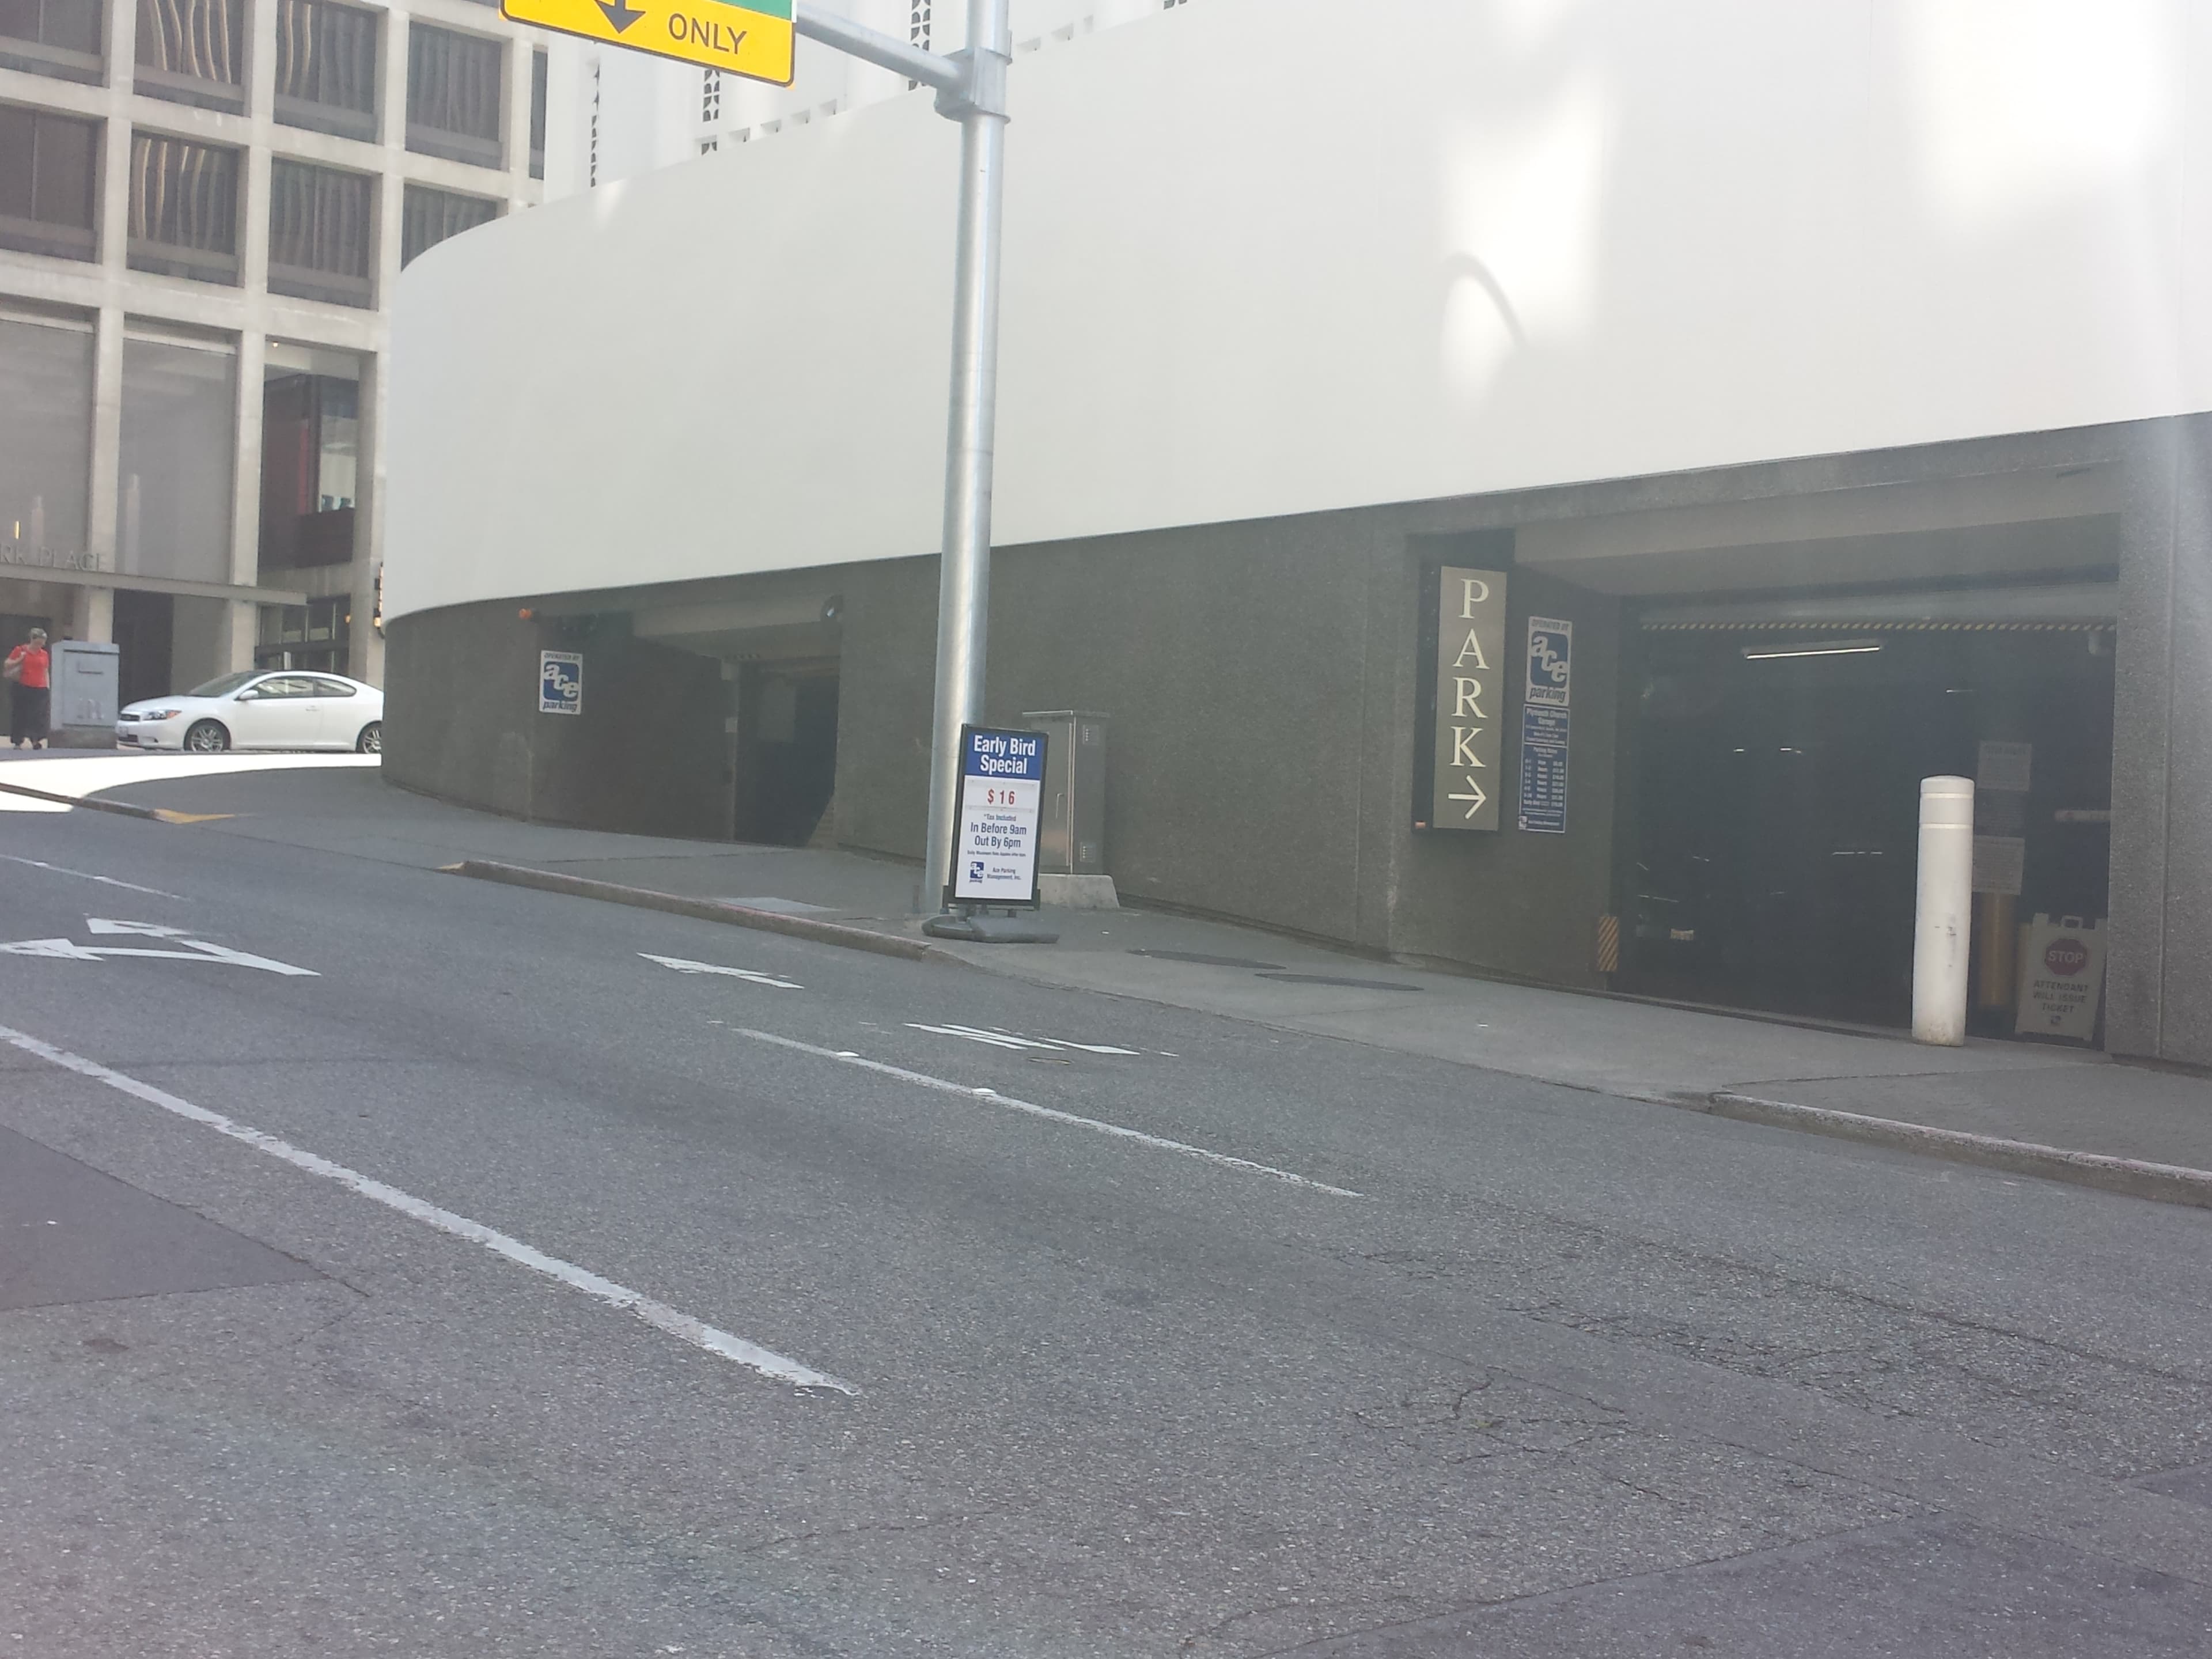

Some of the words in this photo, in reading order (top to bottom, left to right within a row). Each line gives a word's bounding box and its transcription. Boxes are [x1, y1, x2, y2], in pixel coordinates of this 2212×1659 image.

[668, 13, 748, 55] ONLY
[1531, 635, 1569, 683] ace
[543, 664, 578, 698] ace
[1449, 578, 1490, 768] PARK
[1529, 685, 1566, 703] parking
[543, 700, 577, 713] parking
[974, 734, 1007, 757] Early
[1010, 737, 1036, 756] Bird
[980, 754, 1028, 775] Special
[971, 821, 979, 832] In
[981, 822, 1007, 834] Before
[1010, 824, 1027, 835] 9am
[975, 835, 989, 846] Out
[991, 836, 1002, 849] By
[1003, 837, 1021, 850] 6pm
[2048, 950, 2084, 964] STOP
[2033, 980, 2088, 992] ATTENDANT
[2033, 991, 2054, 1000] WILL
[2059, 993, 2088, 1003] ISSUE
[2043, 1003, 2074, 1013] TICKET
